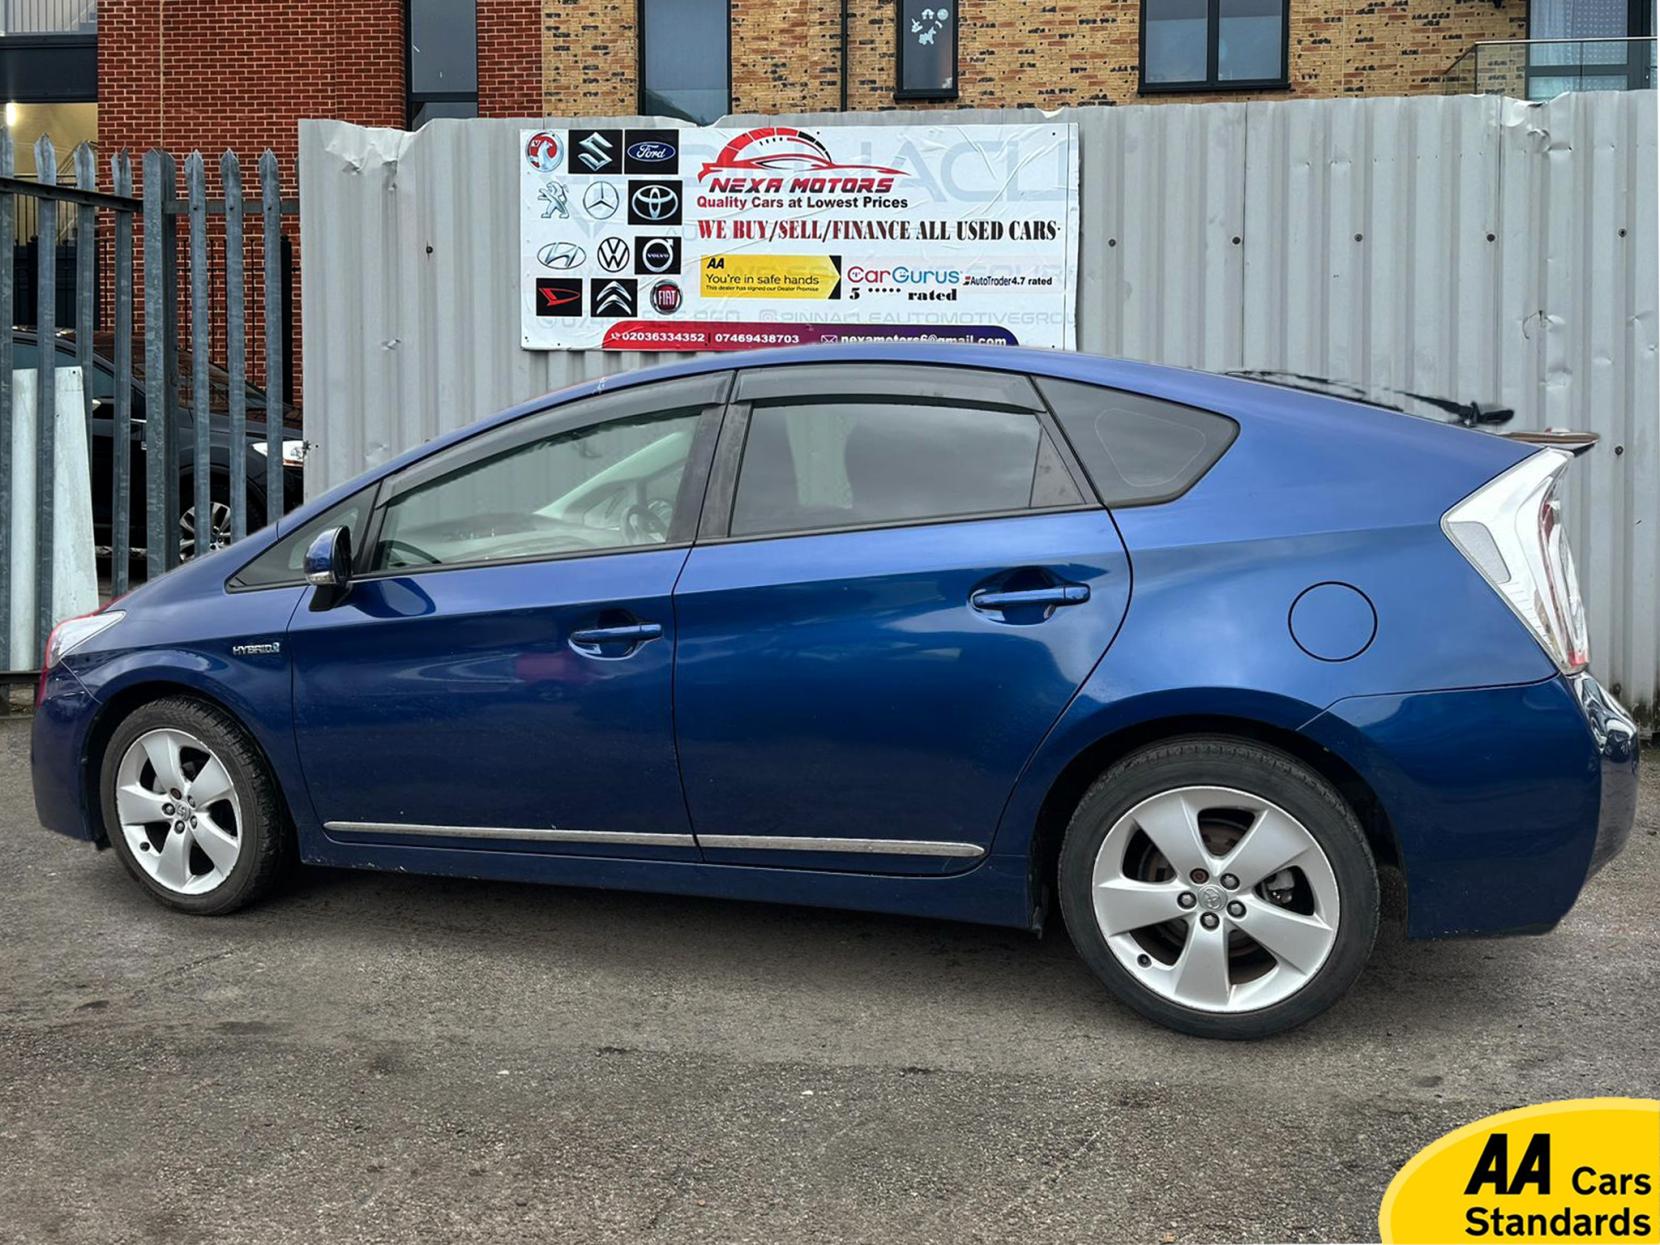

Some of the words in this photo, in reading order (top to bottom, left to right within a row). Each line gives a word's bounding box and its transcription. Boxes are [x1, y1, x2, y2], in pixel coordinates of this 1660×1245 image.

[636, 143, 667, 160] Ford
[709, 177, 783, 194] NEXA
[789, 177, 893, 194] MOTORS
[697, 196, 746, 209] Quality
[752, 196, 784, 208] Cars
[788, 197, 803, 208] at
[807, 196, 859, 208] Lowest
[863, 196, 908, 208] Prices
[697, 219, 727, 239] WE
[733, 219, 910, 241] BUY/SELL/FINANCE
[916, 220, 950, 240] ALL
[956, 220, 1004, 240] USED
[1009, 220, 1057, 240] CARS
[706, 258, 725, 269] AA
[705, 273, 741, 284] You're
[744, 274, 754, 284] in
[757, 274, 781, 285] safe
[784, 275, 820, 285] hands
[847, 265, 960, 285] CarGurus
[1028, 276, 1052, 286] rated
[658, 290, 676, 306] FIAT
[849, 287, 861, 300] 5
[908, 288, 957, 301] rated
[621, 332, 706, 342] 02036334352
[714, 333, 800, 344] 07469438703
[232, 644, 272, 655] HYBRID
